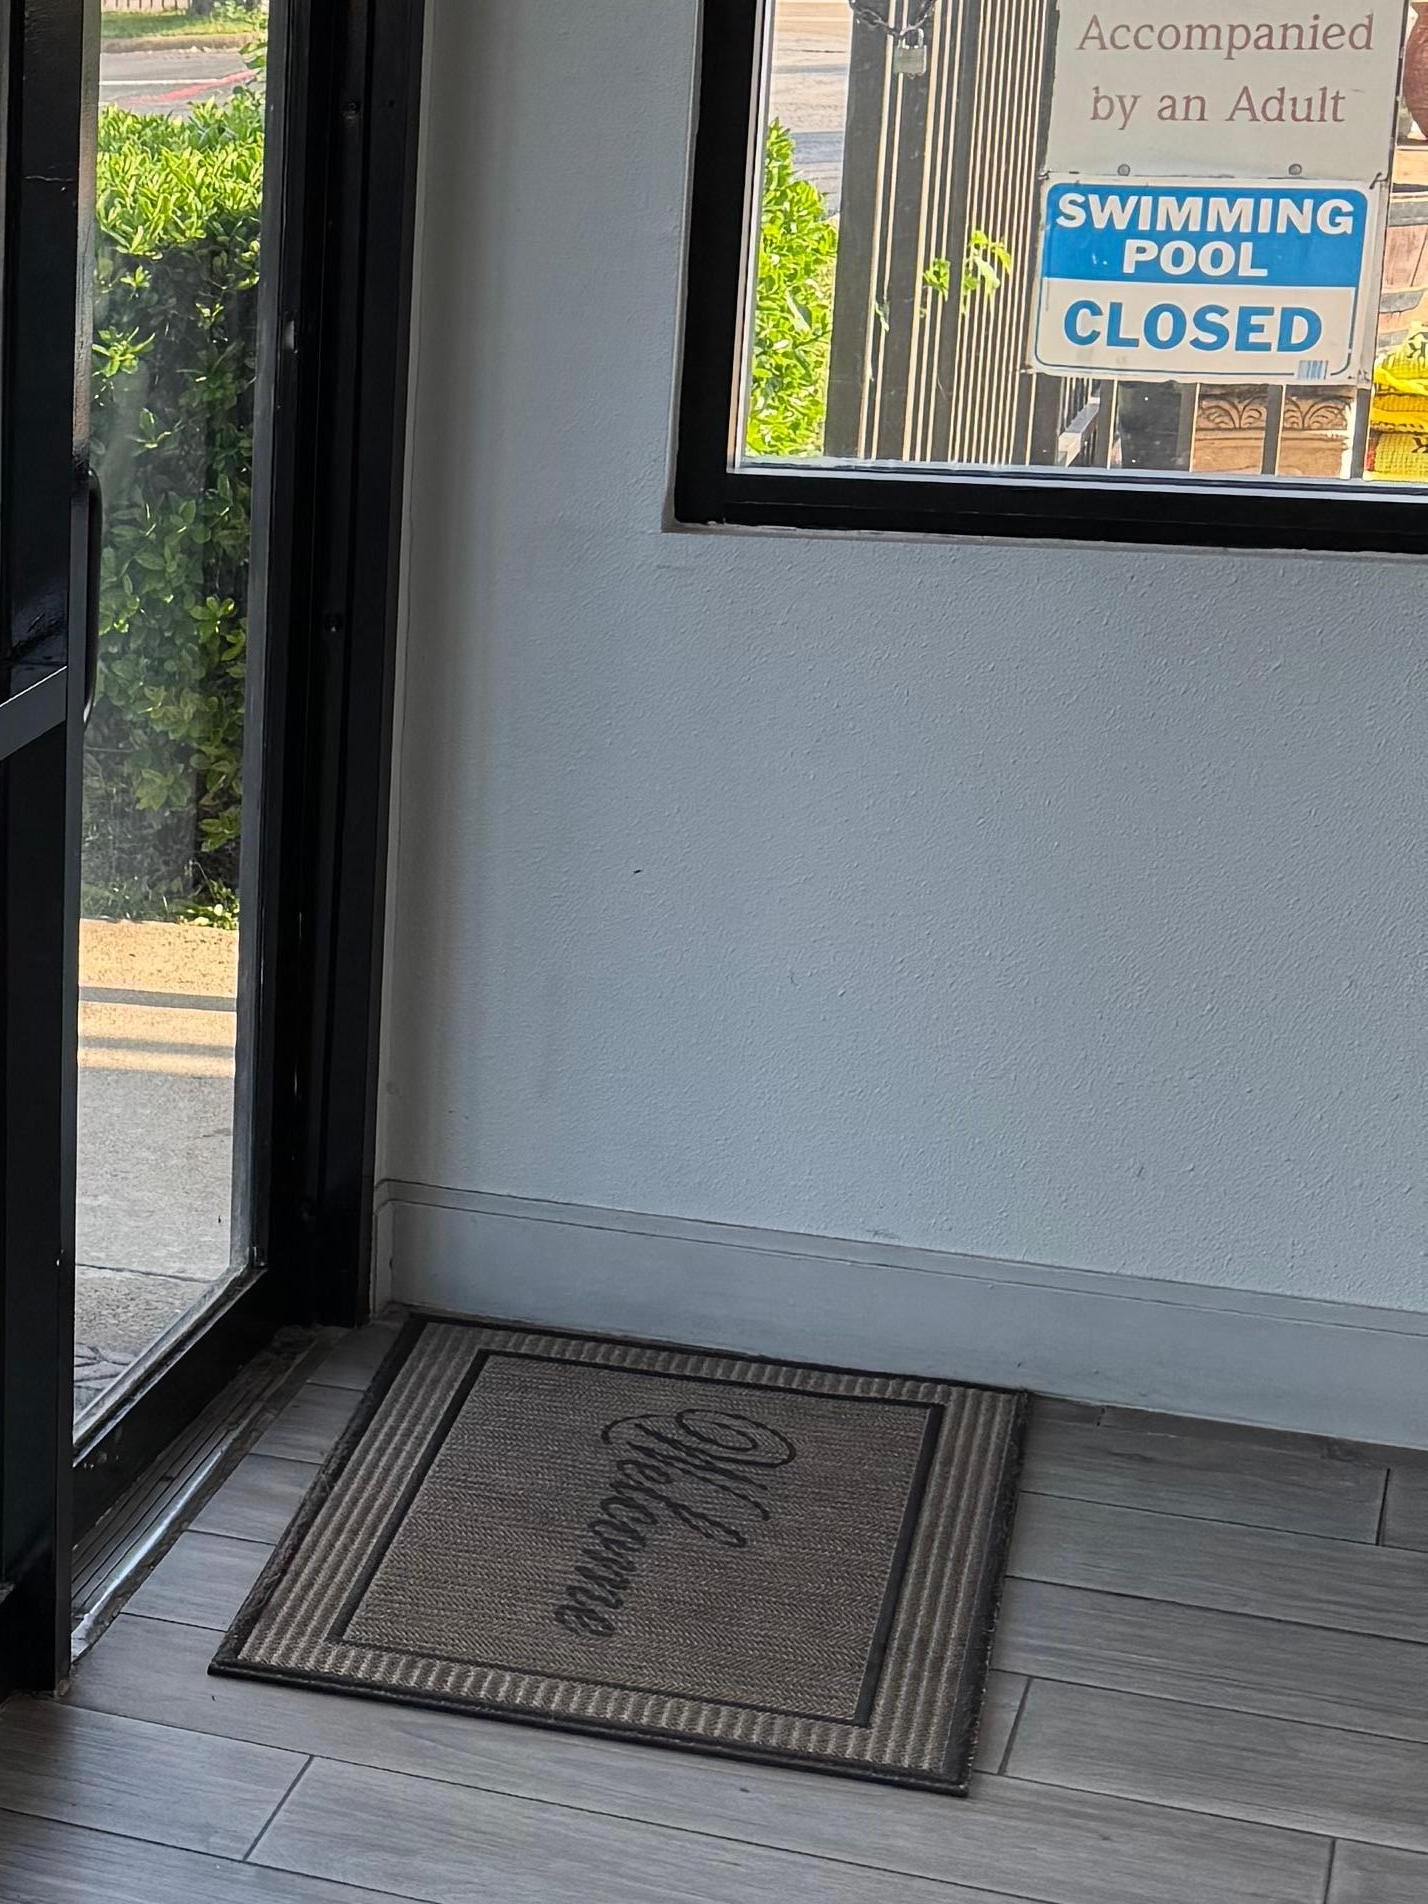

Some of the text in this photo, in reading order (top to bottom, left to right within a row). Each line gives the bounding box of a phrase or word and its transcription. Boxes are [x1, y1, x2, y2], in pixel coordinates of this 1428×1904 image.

[1076, 11, 1376, 61] Accompanied
[1090, 85, 1347, 131] by an Adult
[1056, 192, 1354, 235] SWIMMING
[1122, 239, 1268, 277] POOL
[1064, 299, 1323, 353] CLOSED
[554, 1409, 795, 1637] Welcome
